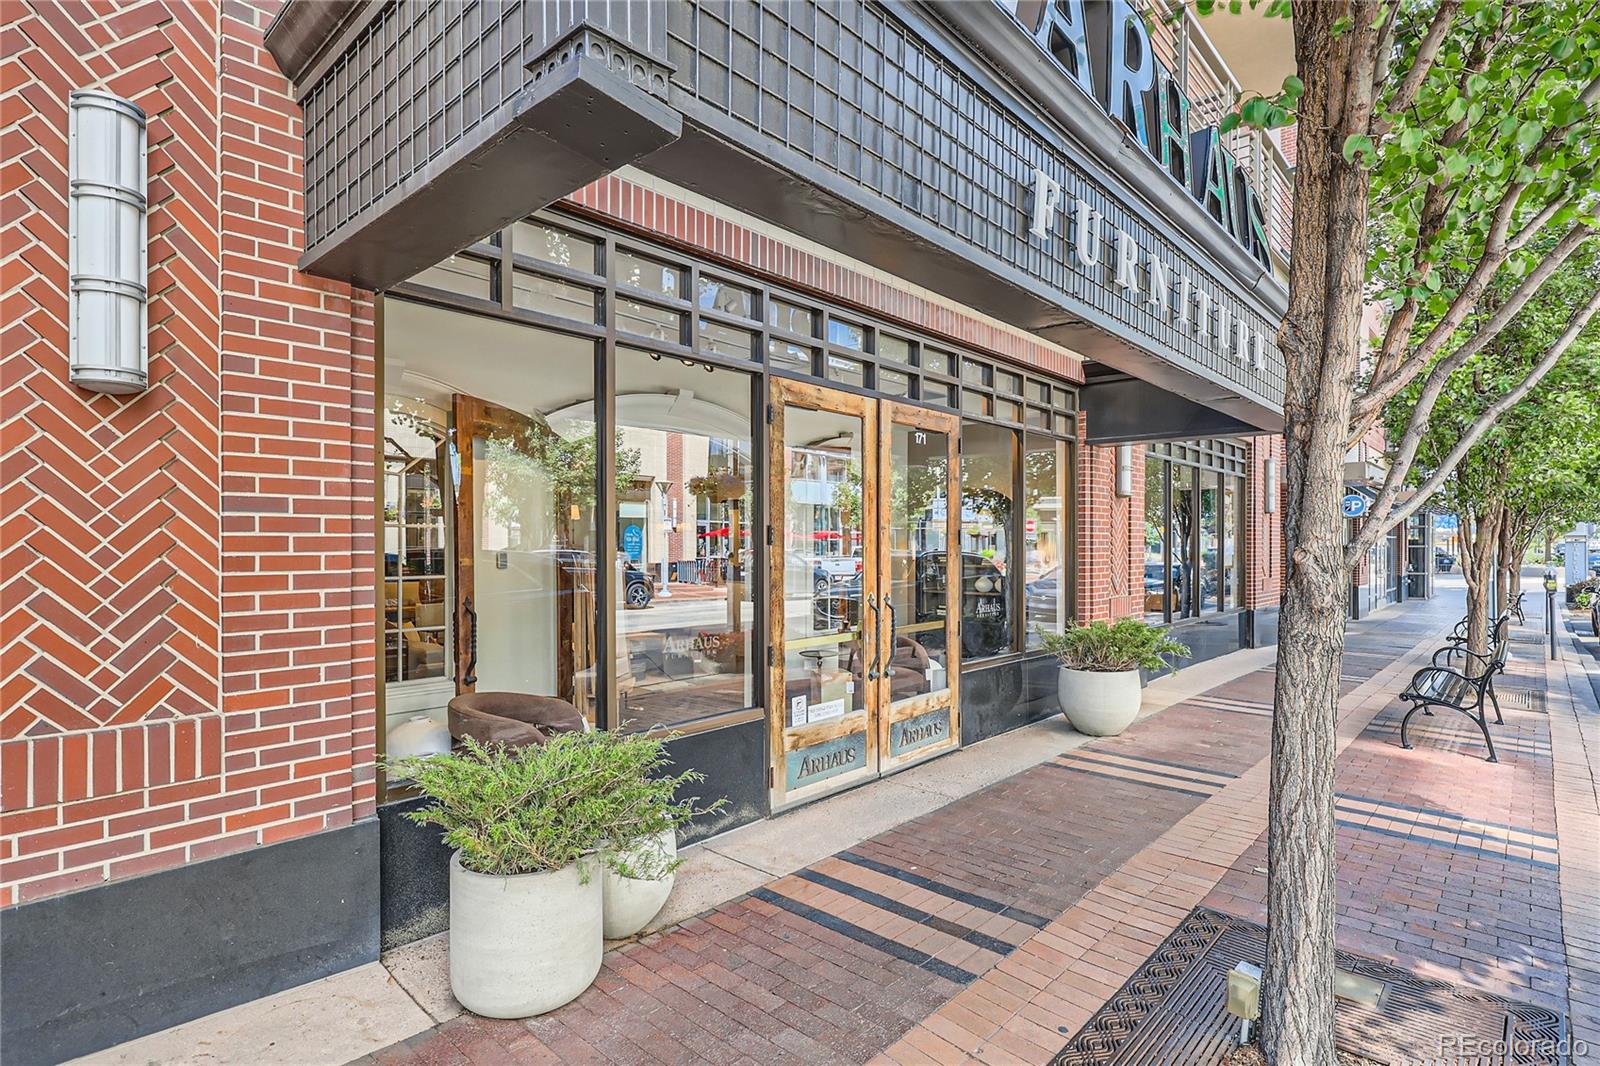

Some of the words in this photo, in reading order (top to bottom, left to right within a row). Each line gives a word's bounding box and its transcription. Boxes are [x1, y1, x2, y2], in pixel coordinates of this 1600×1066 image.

[1033, 0, 1273, 277] ARHAUS
[1028, 168, 1266, 372] FURNITURE
[914, 430, 927, 445] 171
[662, 635, 720, 653] ARHAUS
[898, 719, 944, 749] ARHAUS
[797, 747, 857, 779] ARHAUS
